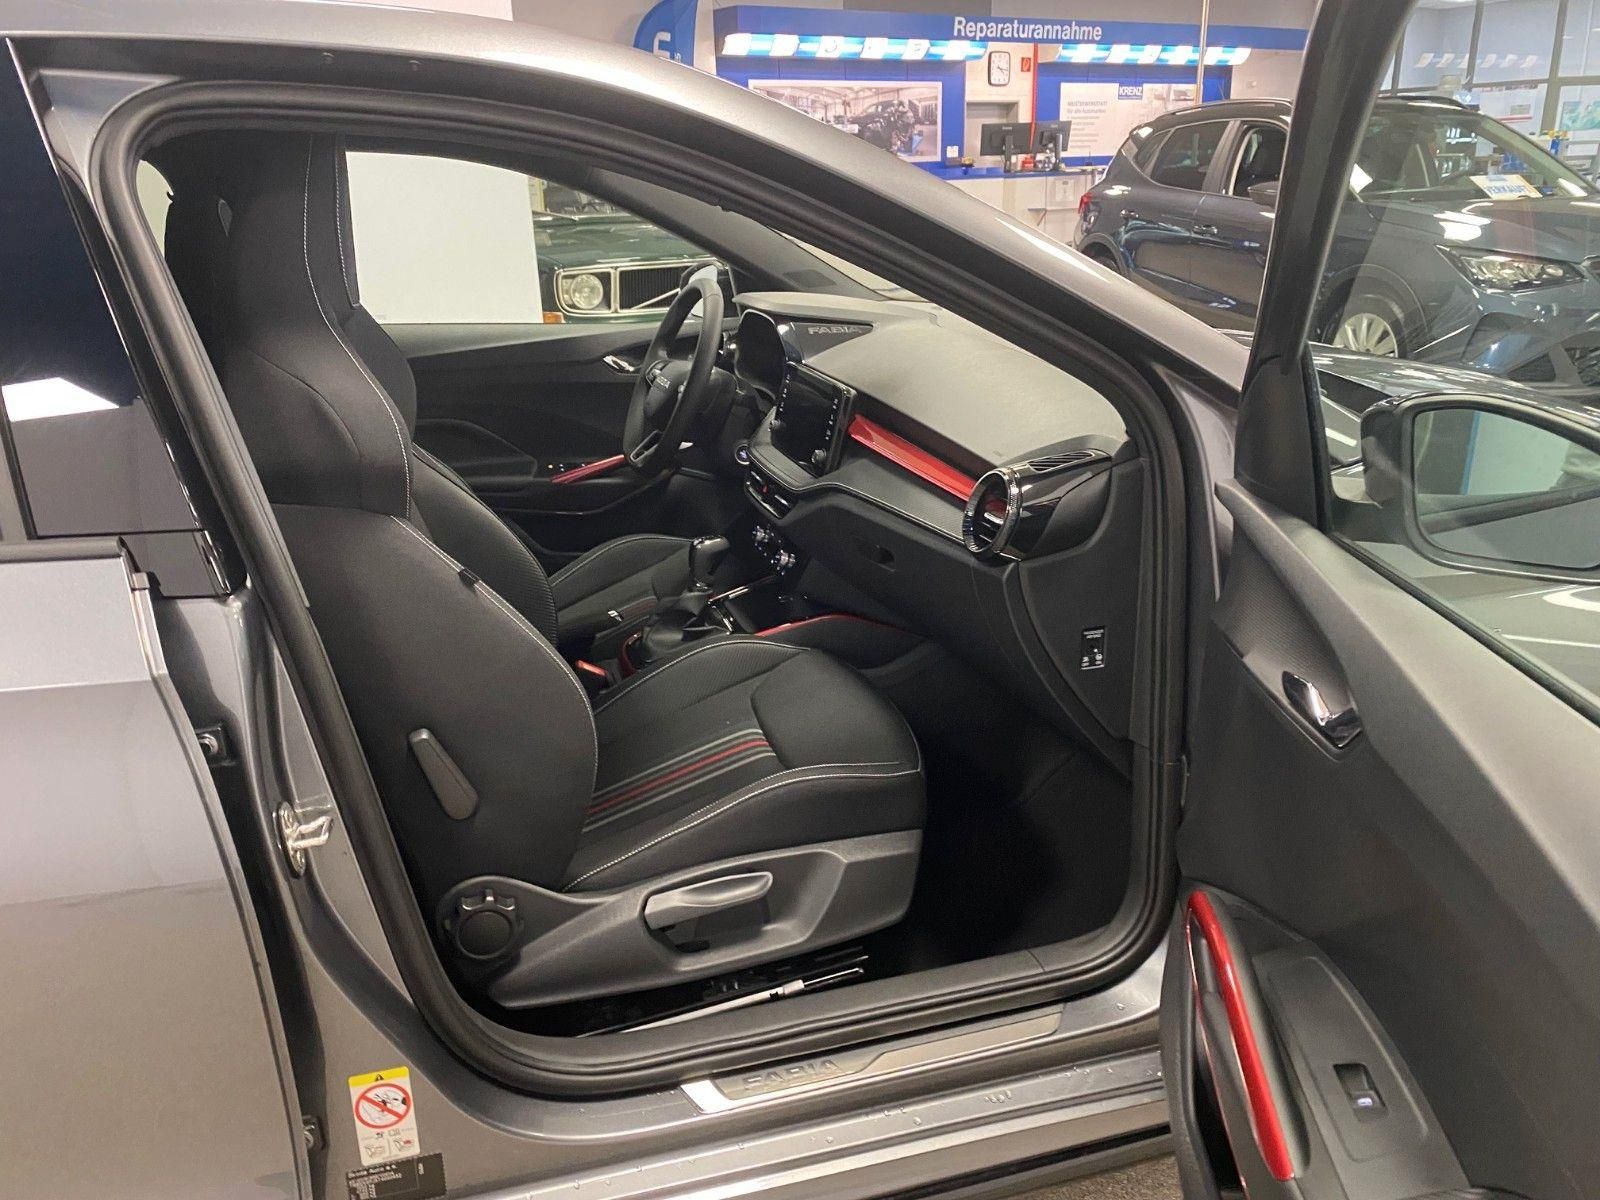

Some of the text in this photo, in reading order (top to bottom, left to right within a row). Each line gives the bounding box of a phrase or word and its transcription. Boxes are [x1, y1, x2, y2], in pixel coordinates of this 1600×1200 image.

[953, 16, 1102, 41] Reparaturannahme
[1119, 86, 1143, 96] KRENZ
[807, 326, 862, 335] FABIA
[742, 1059, 842, 1090] FABIA
